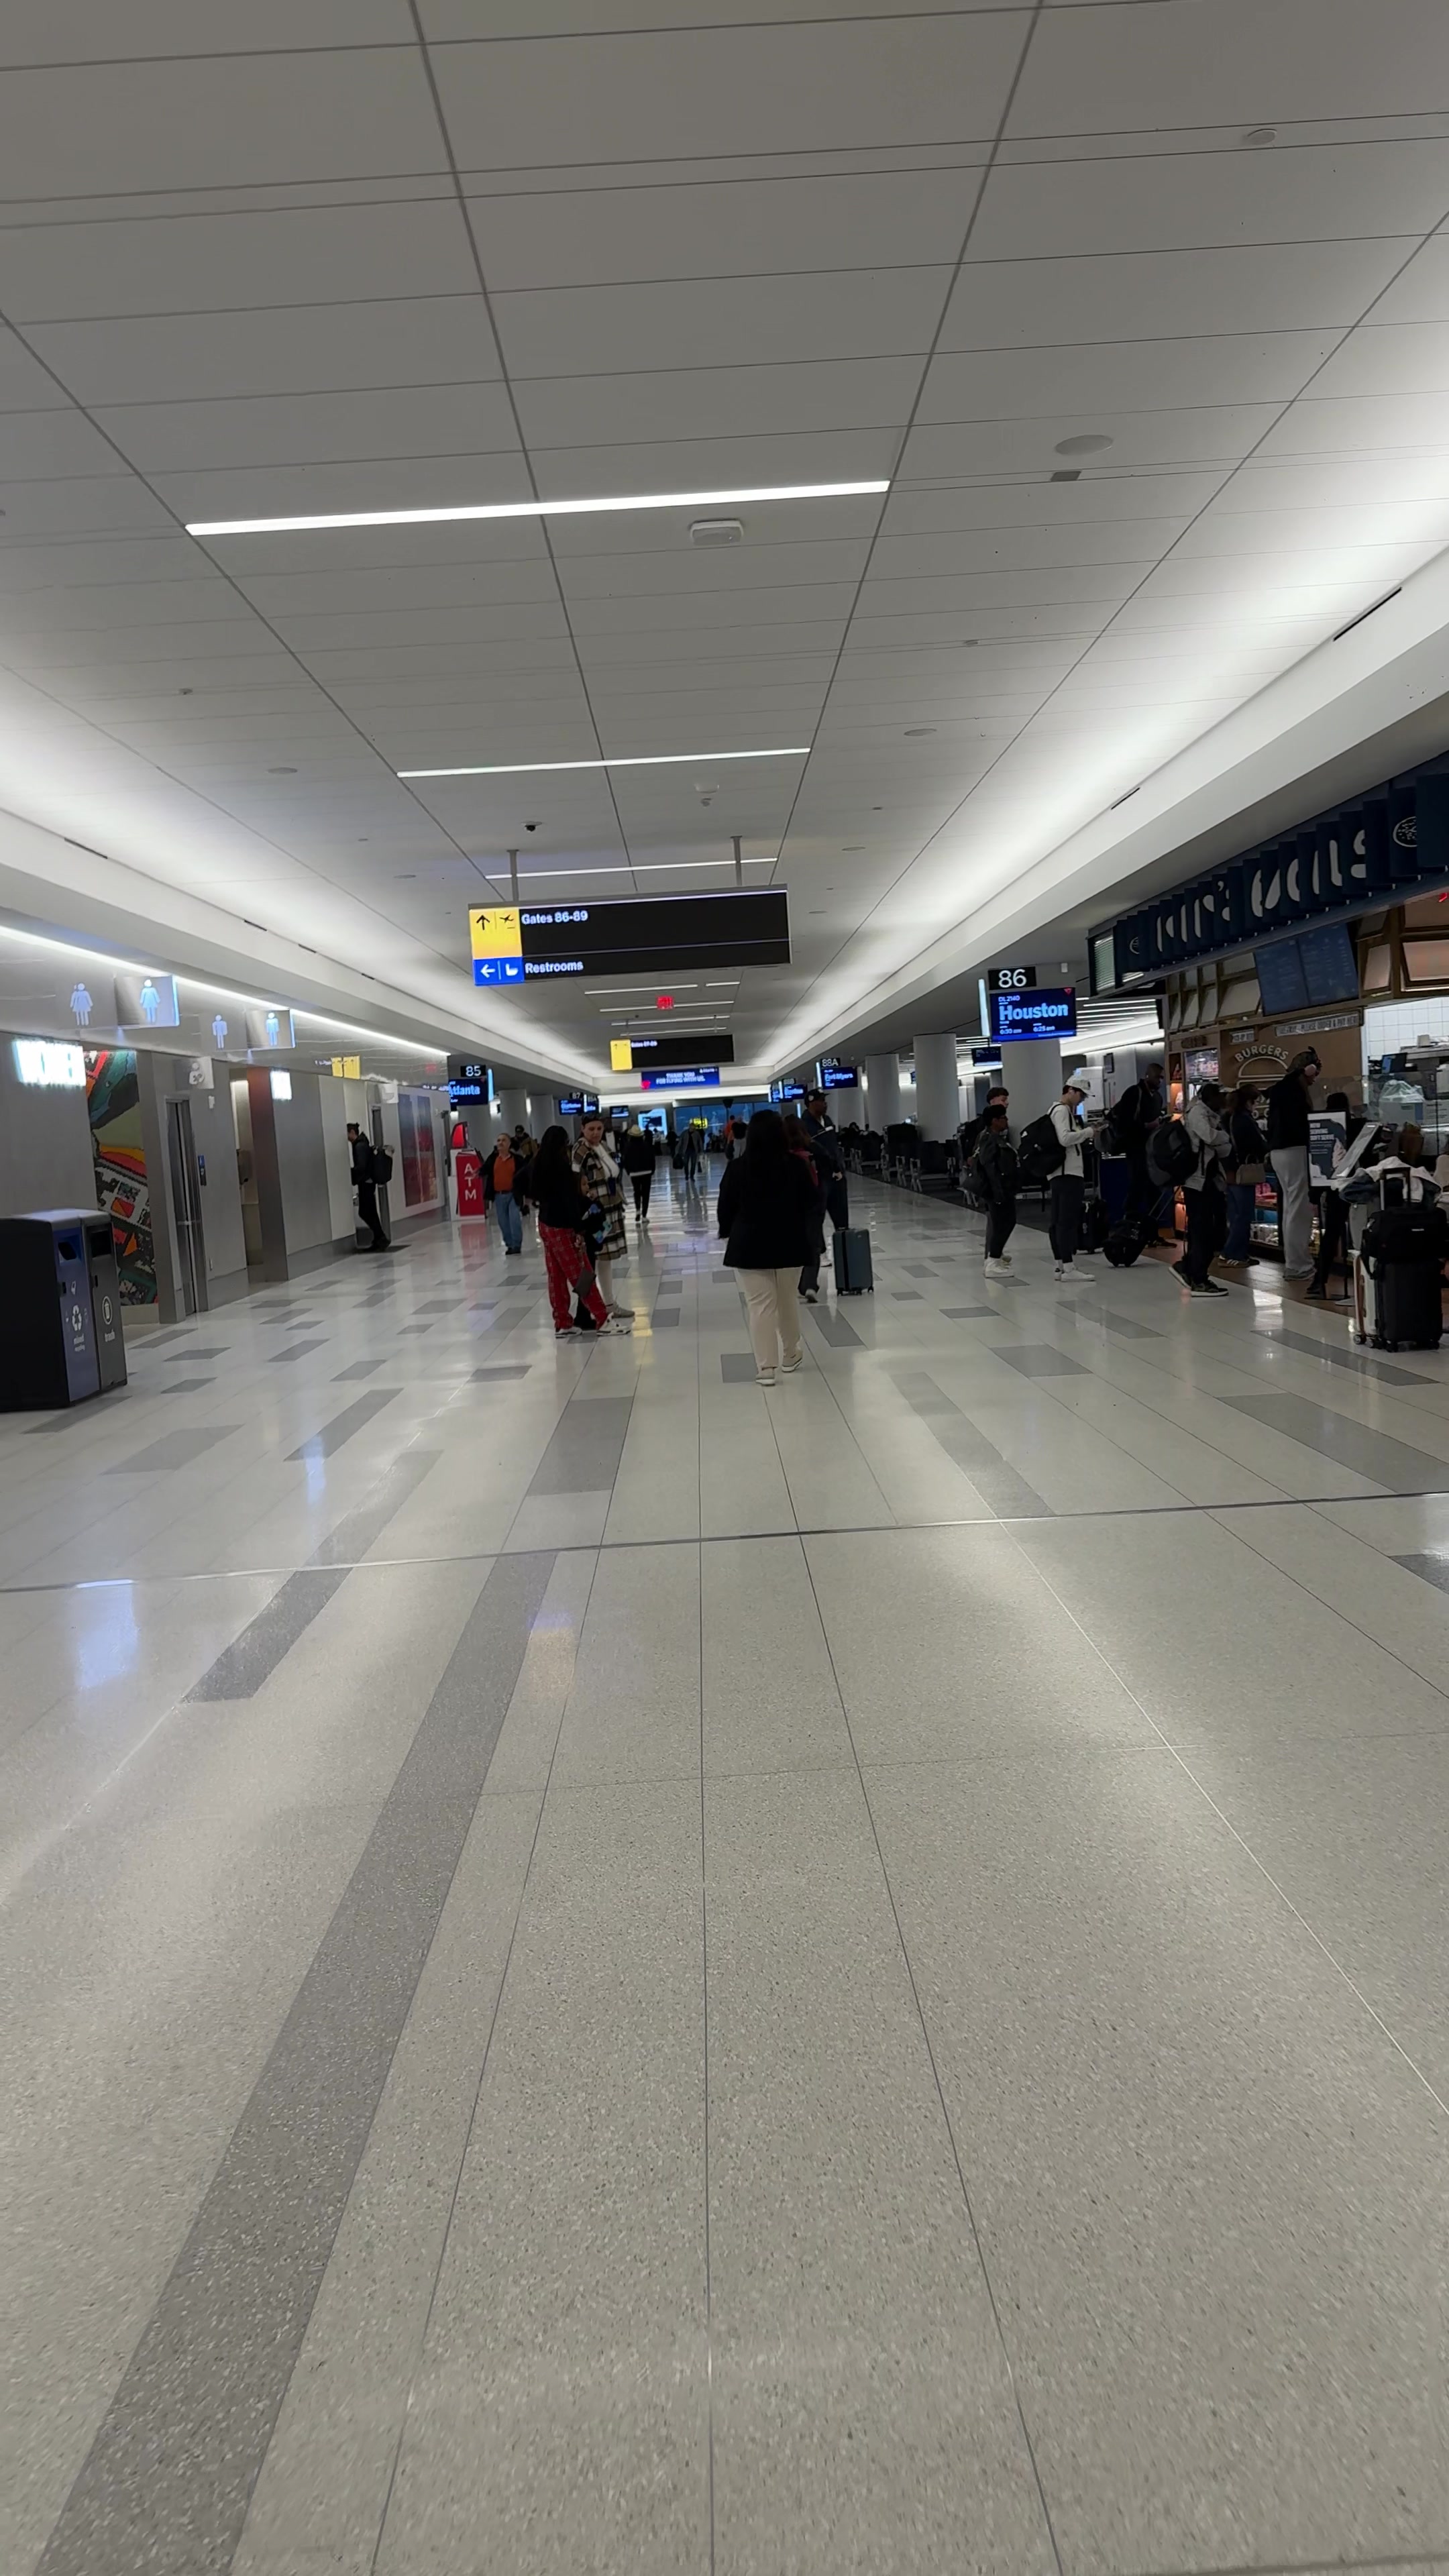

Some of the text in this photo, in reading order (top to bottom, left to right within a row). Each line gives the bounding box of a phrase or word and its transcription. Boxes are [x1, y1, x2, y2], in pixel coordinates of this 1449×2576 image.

[521, 910, 588, 924] Gates 86-89
[525, 961, 584, 973] Restrooms
[998, 969, 1027, 988] 86
[999, 1003, 1069, 1020] Houston
[1234, 1044, 1289, 1062] BURGERS
[822, 1058, 839, 1067] 88A
[466, 1065, 481, 1077] 85
[464, 1163, 477, 1201] ATM
